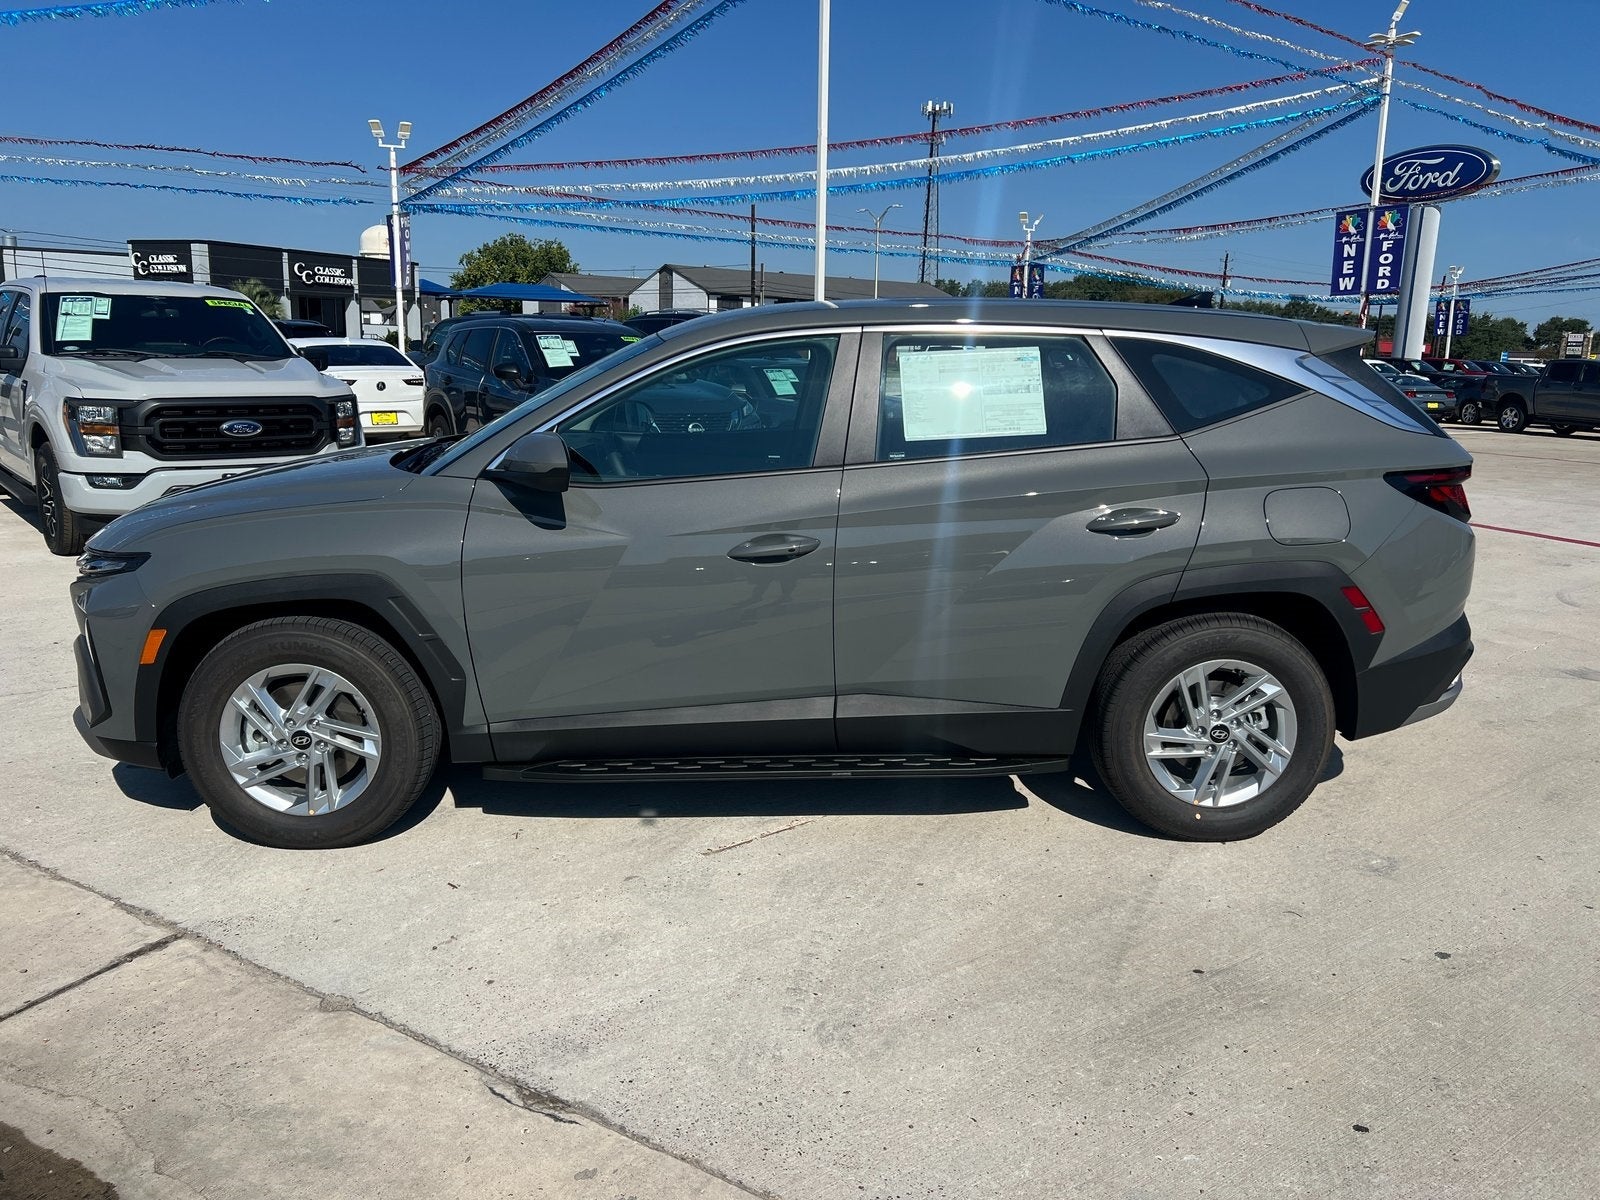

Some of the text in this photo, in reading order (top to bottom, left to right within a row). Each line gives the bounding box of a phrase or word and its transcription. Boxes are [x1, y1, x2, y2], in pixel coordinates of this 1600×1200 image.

[1385, 157, 1464, 193] Ford
[148, 254, 178, 263] CLASSIC
[1338, 243, 1357, 291] NEW
[1376, 240, 1394, 290] FORD
[149, 264, 187, 274] COLLISION
[314, 266, 345, 277] CLASSIC
[314, 275, 354, 286] COLLISION
[1437, 314, 1446, 335] NEW
[1456, 313, 1464, 335] FORD
[267, 639, 333, 656] KUMHO
